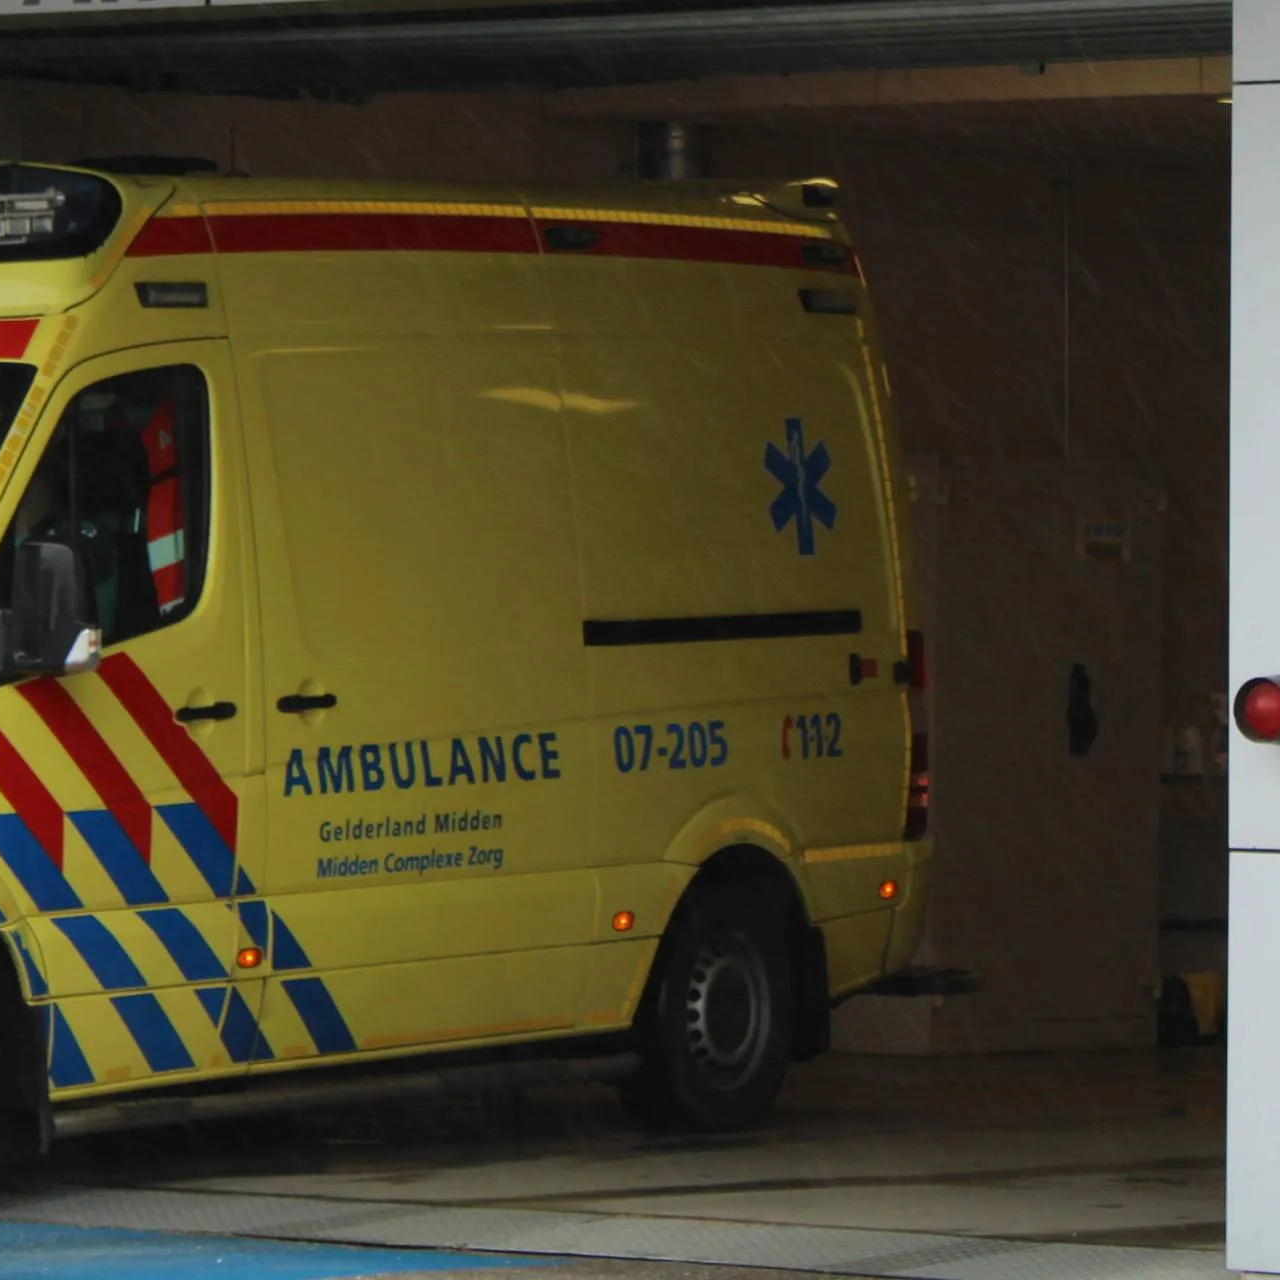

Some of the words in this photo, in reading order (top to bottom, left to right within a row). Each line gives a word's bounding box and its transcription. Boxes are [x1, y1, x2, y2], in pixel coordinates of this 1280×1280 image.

[283, 732, 561, 797] AMBULANCE
[614, 720, 729, 773] 07-205
[319, 814, 427, 843] Gelderland
[433, 810, 503, 835] Midden
[316, 853, 378, 879] Midden
[384, 848, 464, 876] Complexe
[468, 845, 504, 870] Zorg
